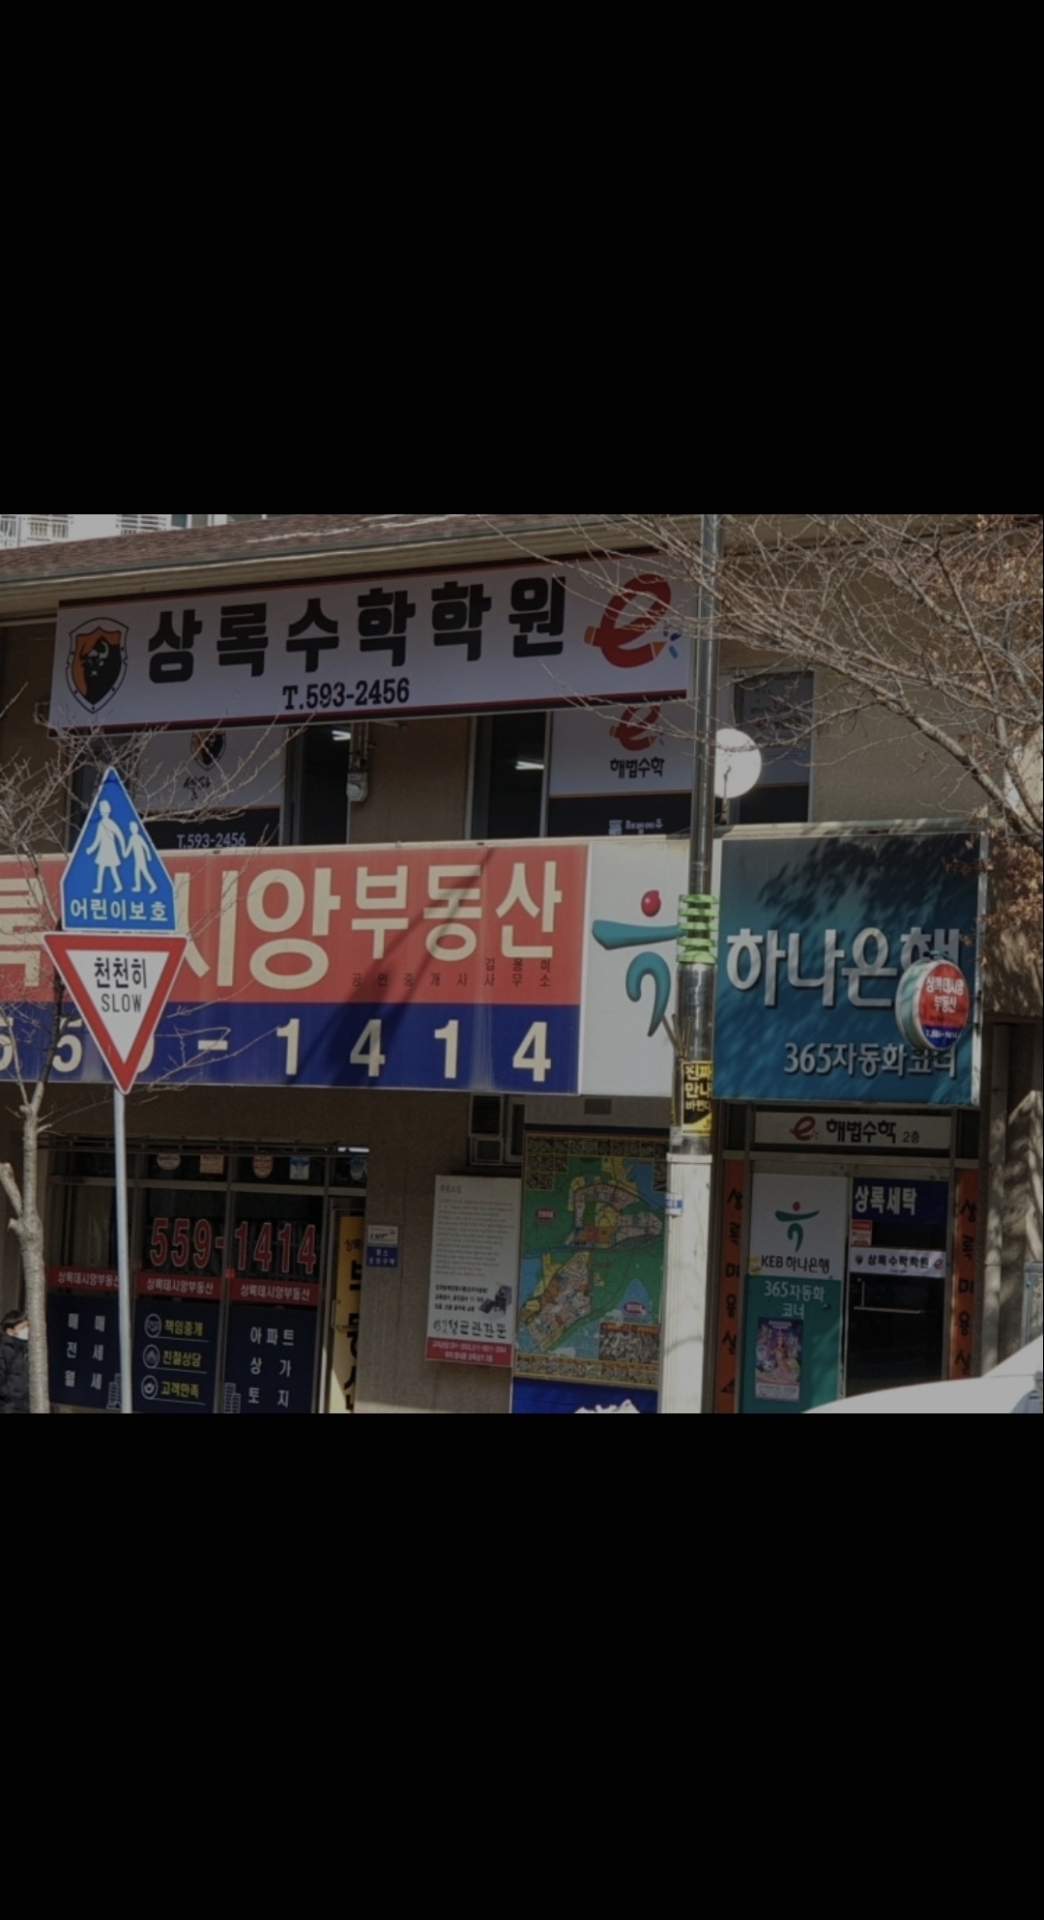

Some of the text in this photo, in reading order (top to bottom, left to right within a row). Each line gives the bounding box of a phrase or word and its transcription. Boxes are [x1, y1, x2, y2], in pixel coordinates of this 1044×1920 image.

[148, 576, 567, 684] 상록수학학원
[282, 678, 410, 711] T.593-2456
[610, 756, 665, 779] 해법수학
[176, 832, 247, 849] T.593-2456
[70, 897, 169, 923] 어린이보호
[93, 957, 147, 989] 천천히
[101, 993, 142, 1013] SLOW
[826, 1119, 920, 1143] 해법수학 2층
[854, 1185, 917, 1216] 상록세탁
[149, 1217, 317, 1274] 559-1414
[761, 1256, 831, 1274] KEB 하나은행
[764, 1281, 825, 1303] 365자동화
[781, 1303, 805, 1320] 코너
[164, 1320, 204, 1337] 책임중개
[250, 1326, 295, 1347] 아파트
[162, 1350, 202, 1368] 친절상담
[250, 1357, 292, 1378] 상가
[161, 1381, 200, 1399] 고객만족
[247, 1387, 290, 1408] 토지
